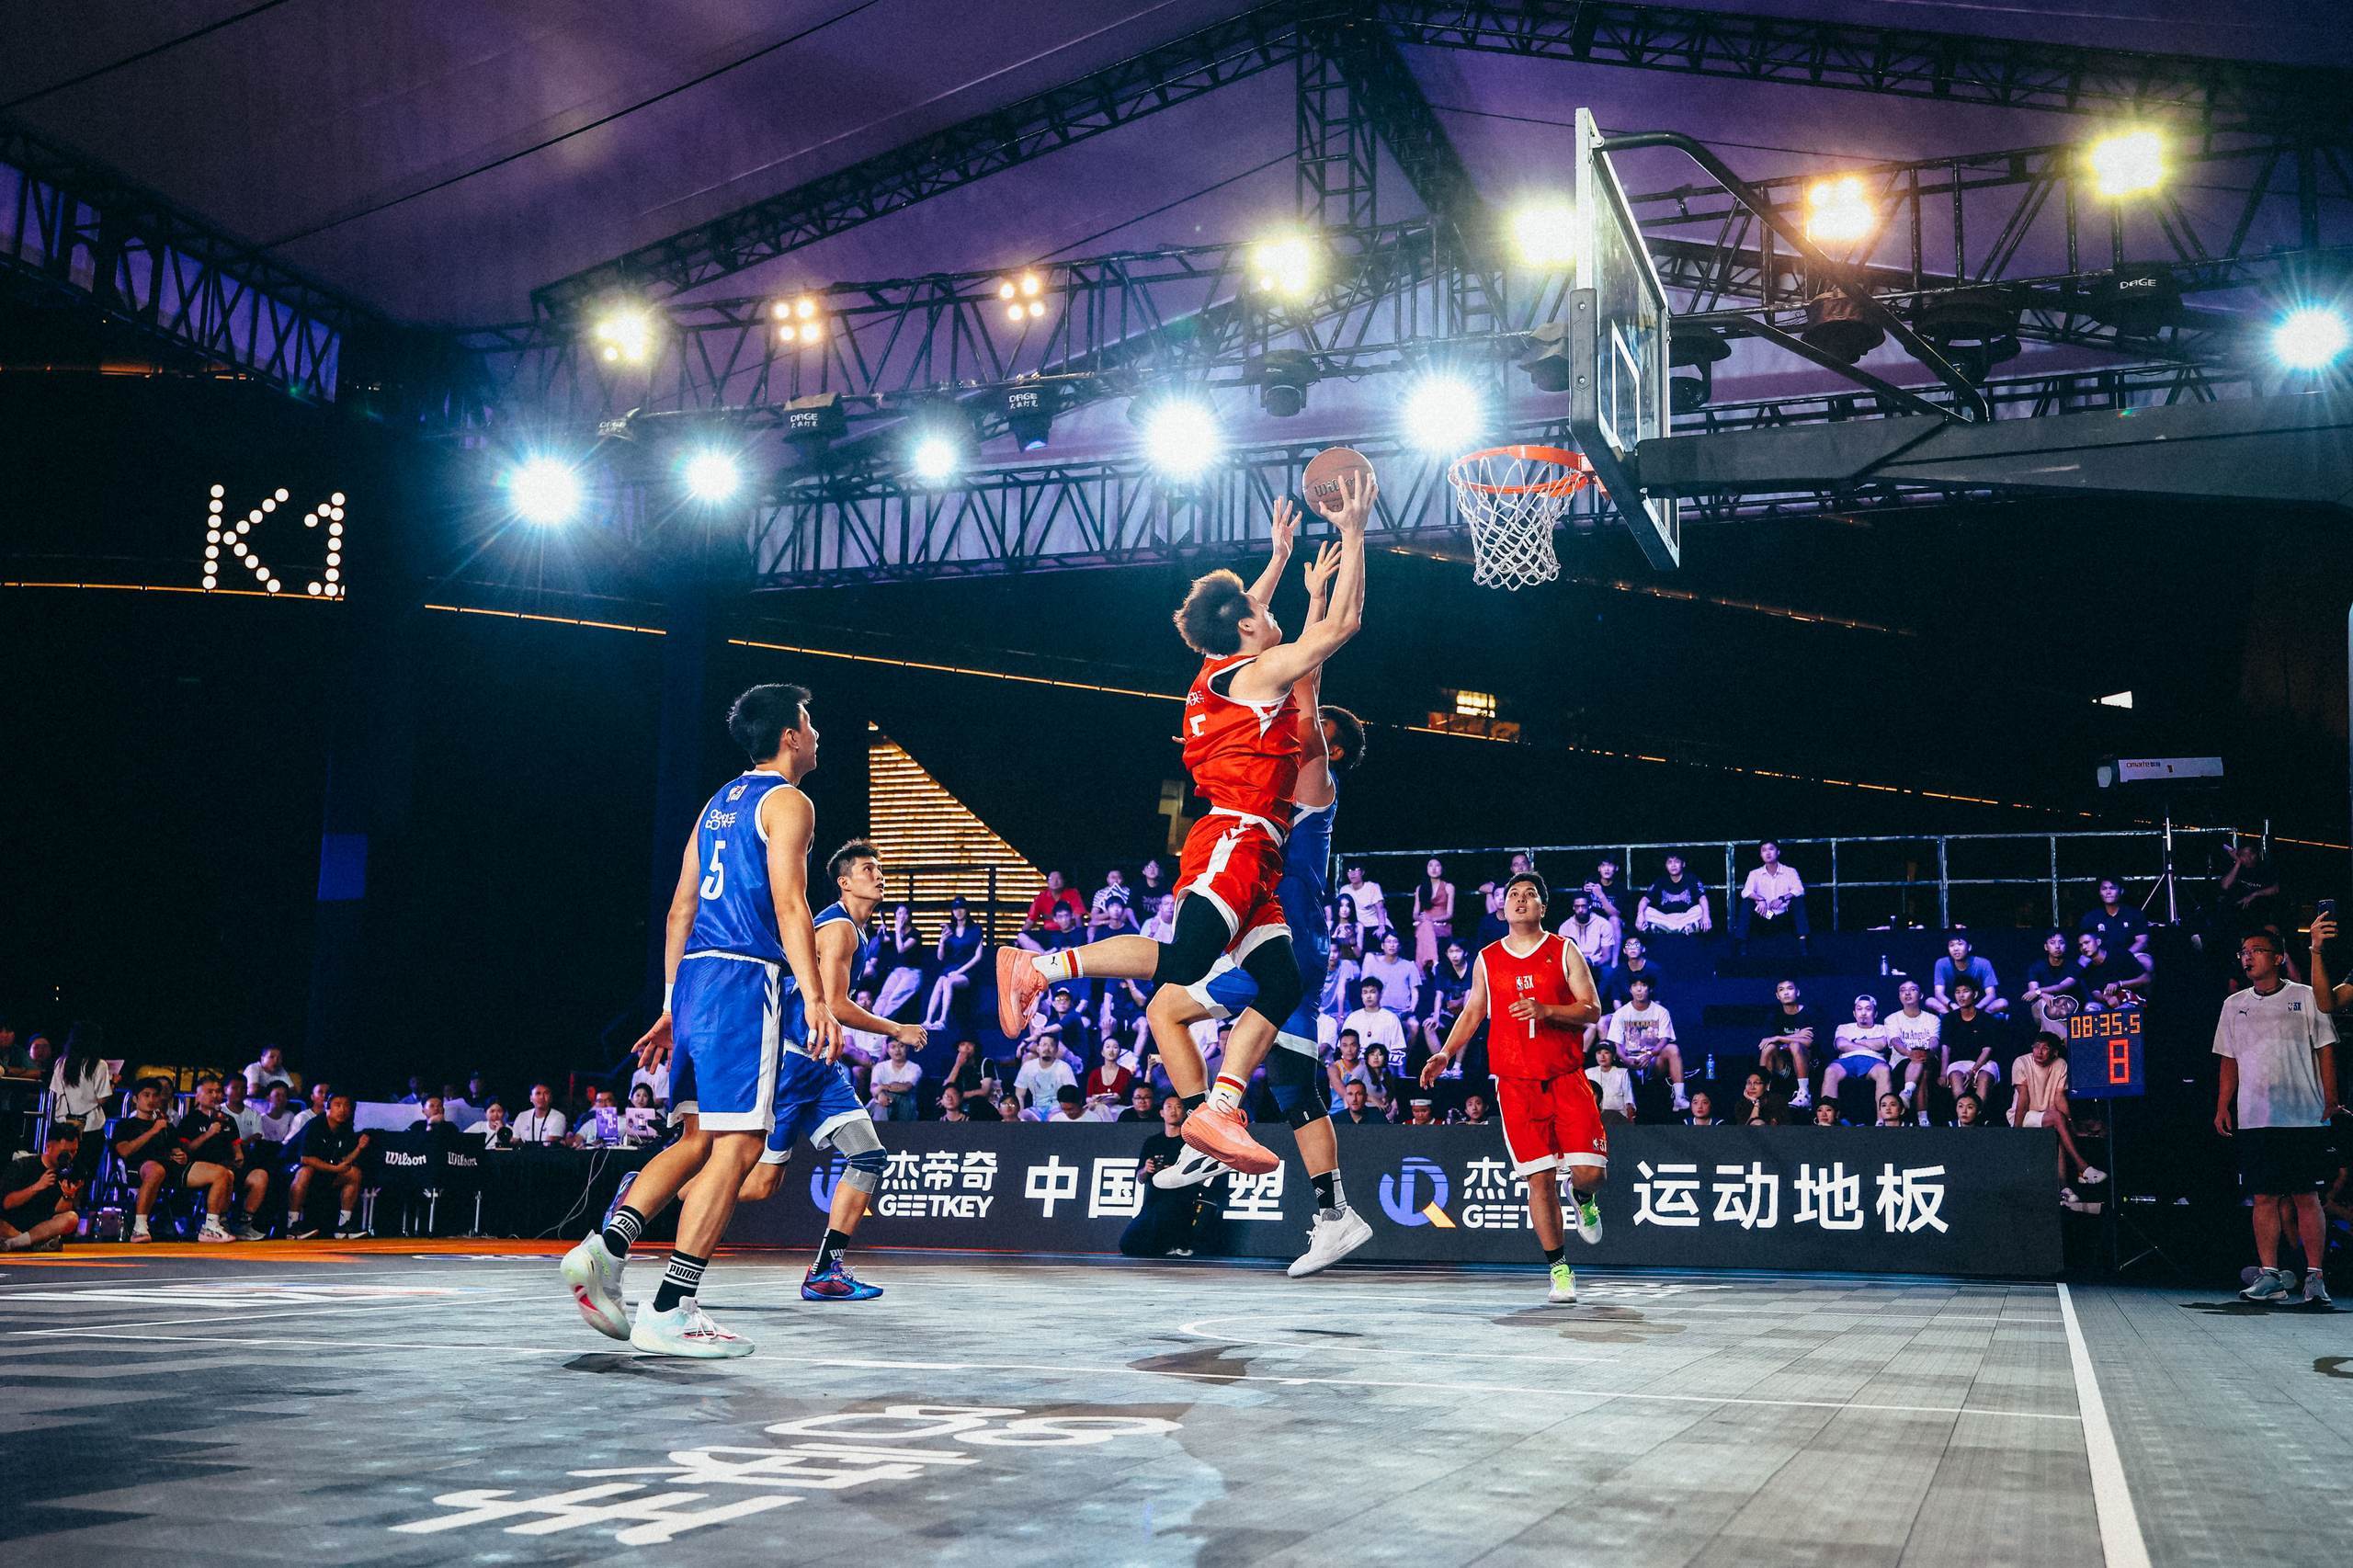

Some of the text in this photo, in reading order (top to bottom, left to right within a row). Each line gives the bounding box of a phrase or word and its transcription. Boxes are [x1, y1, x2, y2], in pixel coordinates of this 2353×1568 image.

[2120, 278, 2157, 290] DAGE
[1008, 392, 1038, 403] DAGE
[790, 413, 818, 423] DAGE
[699, 839, 726, 901] 5
[1522, 974, 1534, 989] 3X
[2070, 1012, 2141, 1039] 08:35.5
[2109, 1039, 2130, 1084] 8
[385, 1151, 427, 1166] Wilson
[447, 1151, 478, 1166] Wilson
[881, 1150, 998, 1191] 杰帝奇
[1024, 1154, 1286, 1221] 中国塑
[1633, 1160, 1949, 1234] 运动地板
[878, 1194, 995, 1218] GEETKEY
[669, 1264, 701, 1281] PUMA
